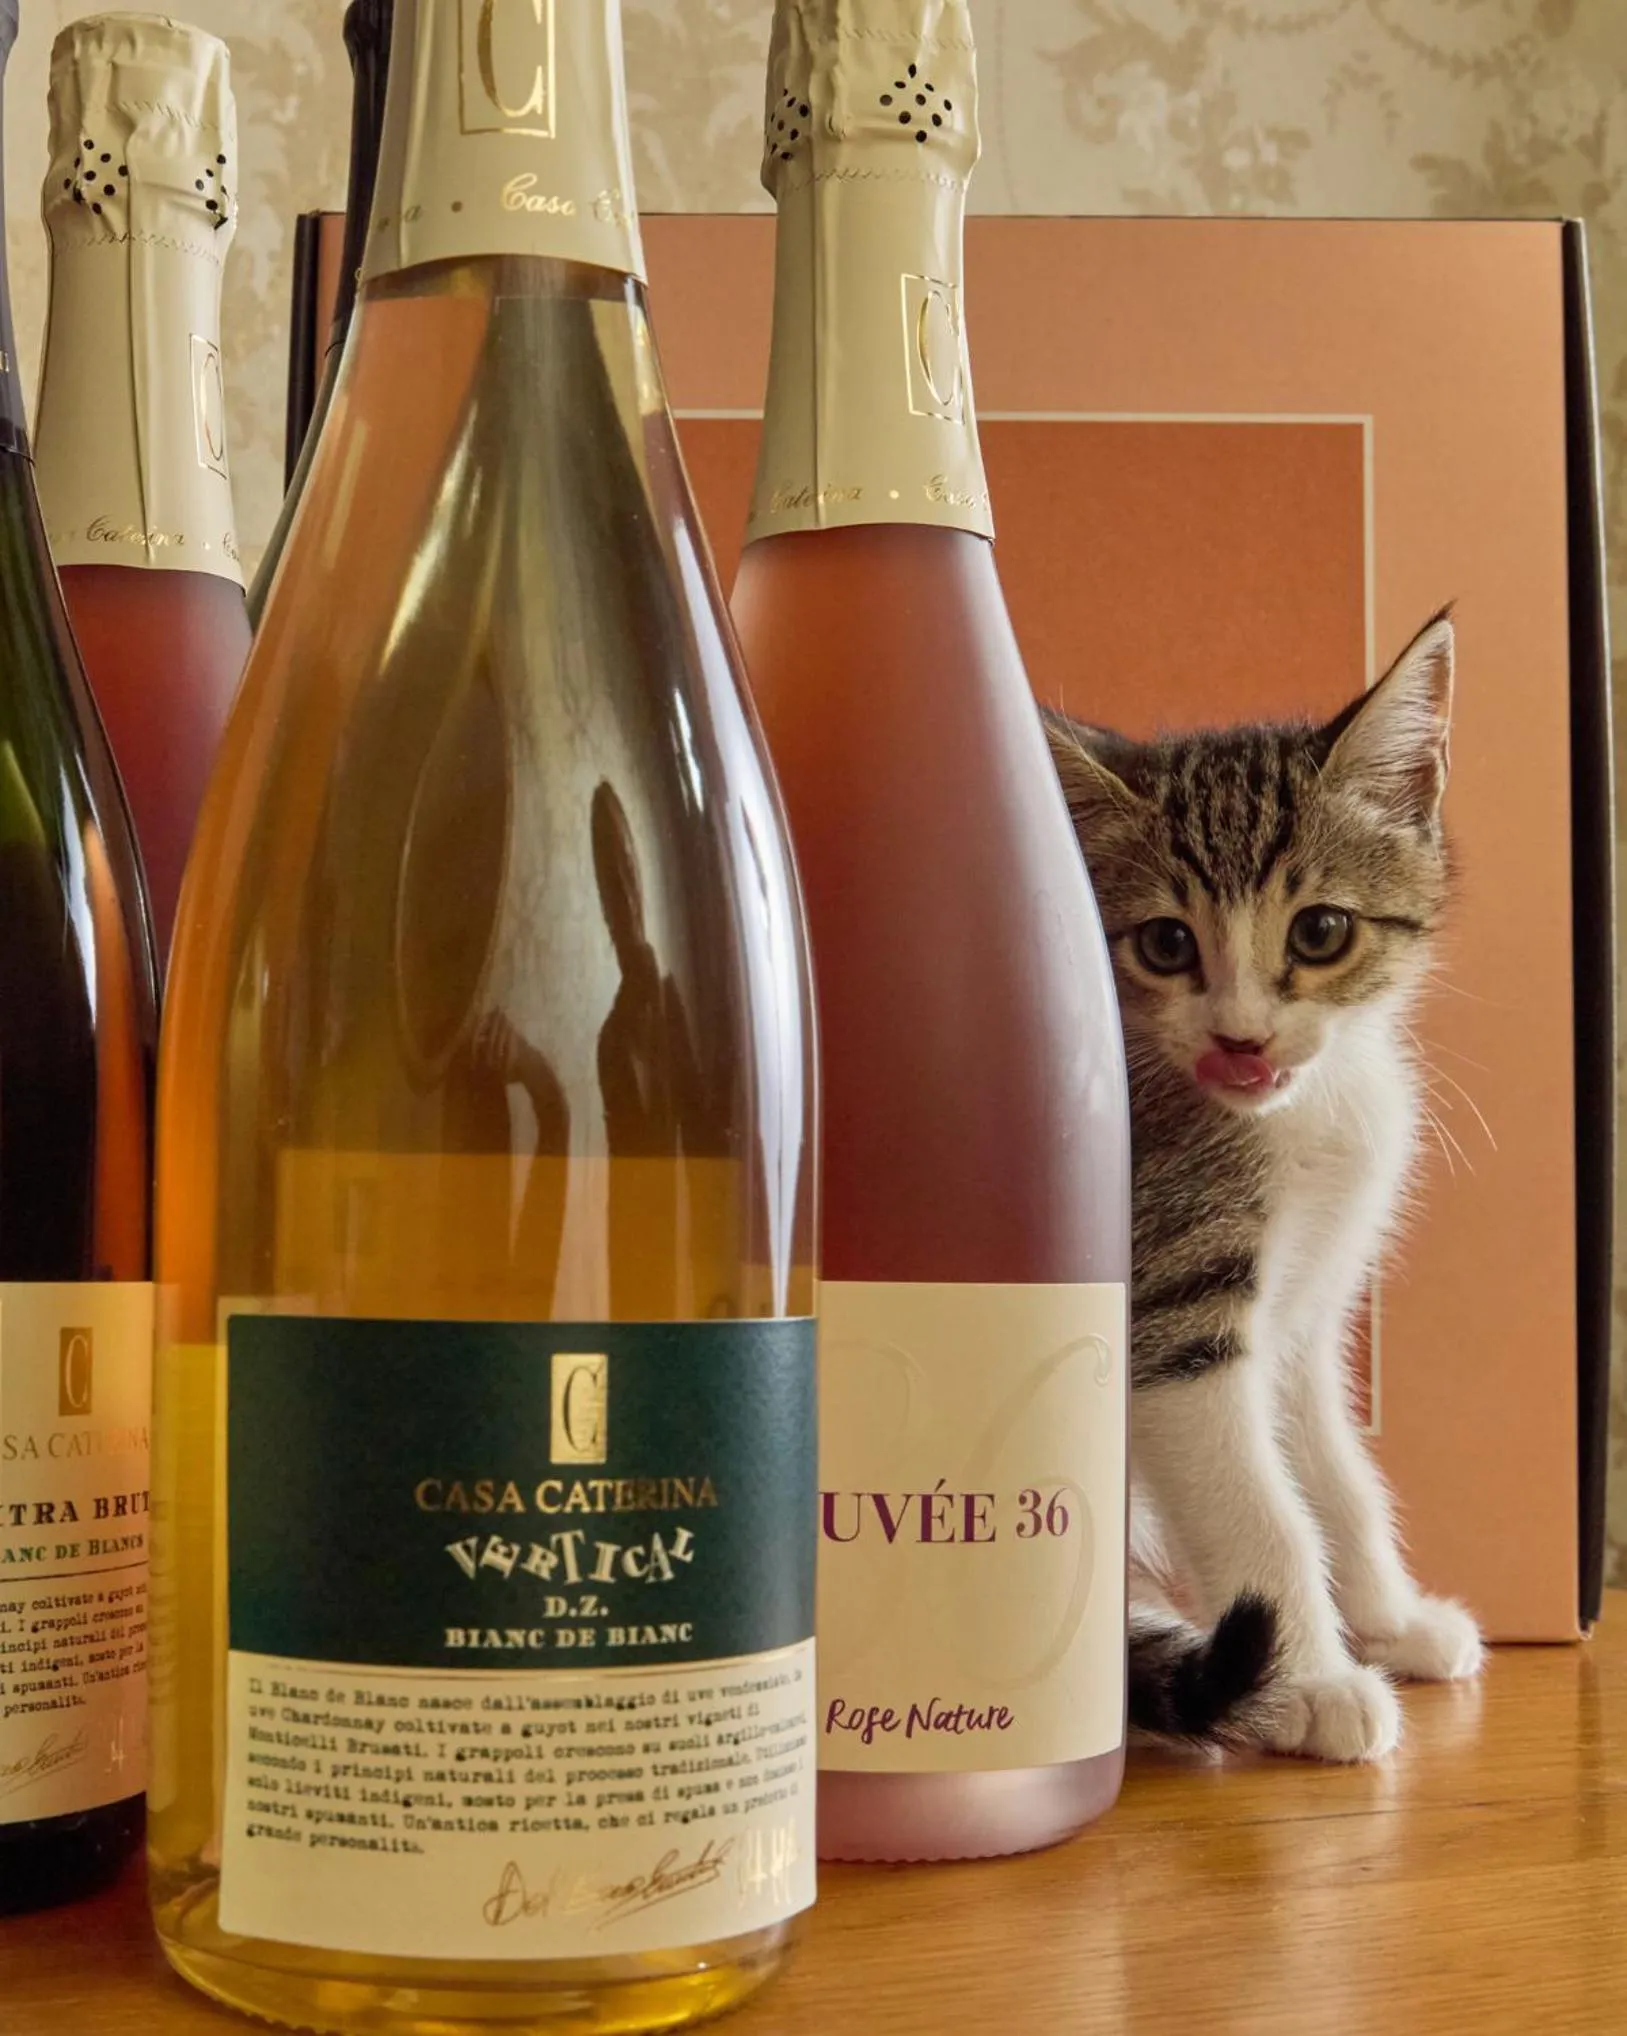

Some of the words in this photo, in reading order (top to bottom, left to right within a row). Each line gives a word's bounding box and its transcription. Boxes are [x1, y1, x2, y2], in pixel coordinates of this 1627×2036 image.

[770, 476, 863, 514] Cateina
[2, 1434, 40, 1460] SA
[414, 1478, 527, 1514] CASA
[535, 1476, 718, 1514] CATERINA
[0, 1500, 79, 1527] TRA
[820, 1478, 996, 1544] UVÉE
[1015, 1487, 1070, 1538] 36
[0, 1546, 48, 1563] ANC
[55, 1543, 81, 1560] DE
[445, 1526, 695, 1585] VERTICAL
[0, 1601, 25, 1614] nay
[543, 1595, 609, 1617] D.Z.
[0, 1640, 47, 1655] incipi
[555, 1628, 597, 1647] DE
[0, 1661, 15, 1673] ti
[271, 1681, 319, 1700] Blanc
[325, 1687, 346, 1703] de
[354, 1689, 410, 1707] Blanc
[282, 1707, 385, 1734] Chardonnay
[393, 1718, 492, 1735] coltivate
[501, 1723, 512, 1735] a
[521, 1720, 577, 1738] guyot
[625, 1713, 679, 1731] nostri
[906, 1697, 1014, 1738] Nature
[249, 1726, 337, 1752] Monticelli
[438, 1744, 447, 1757] I
[456, 1744, 544, 1763] grappoli
[332, 1764, 414, 1783] principi
[424, 1769, 515, 1783] naturali
[462, 1793, 516, 1808] mosto
[525, 1794, 556, 1810] per
[598, 1815, 629, 1829] che
